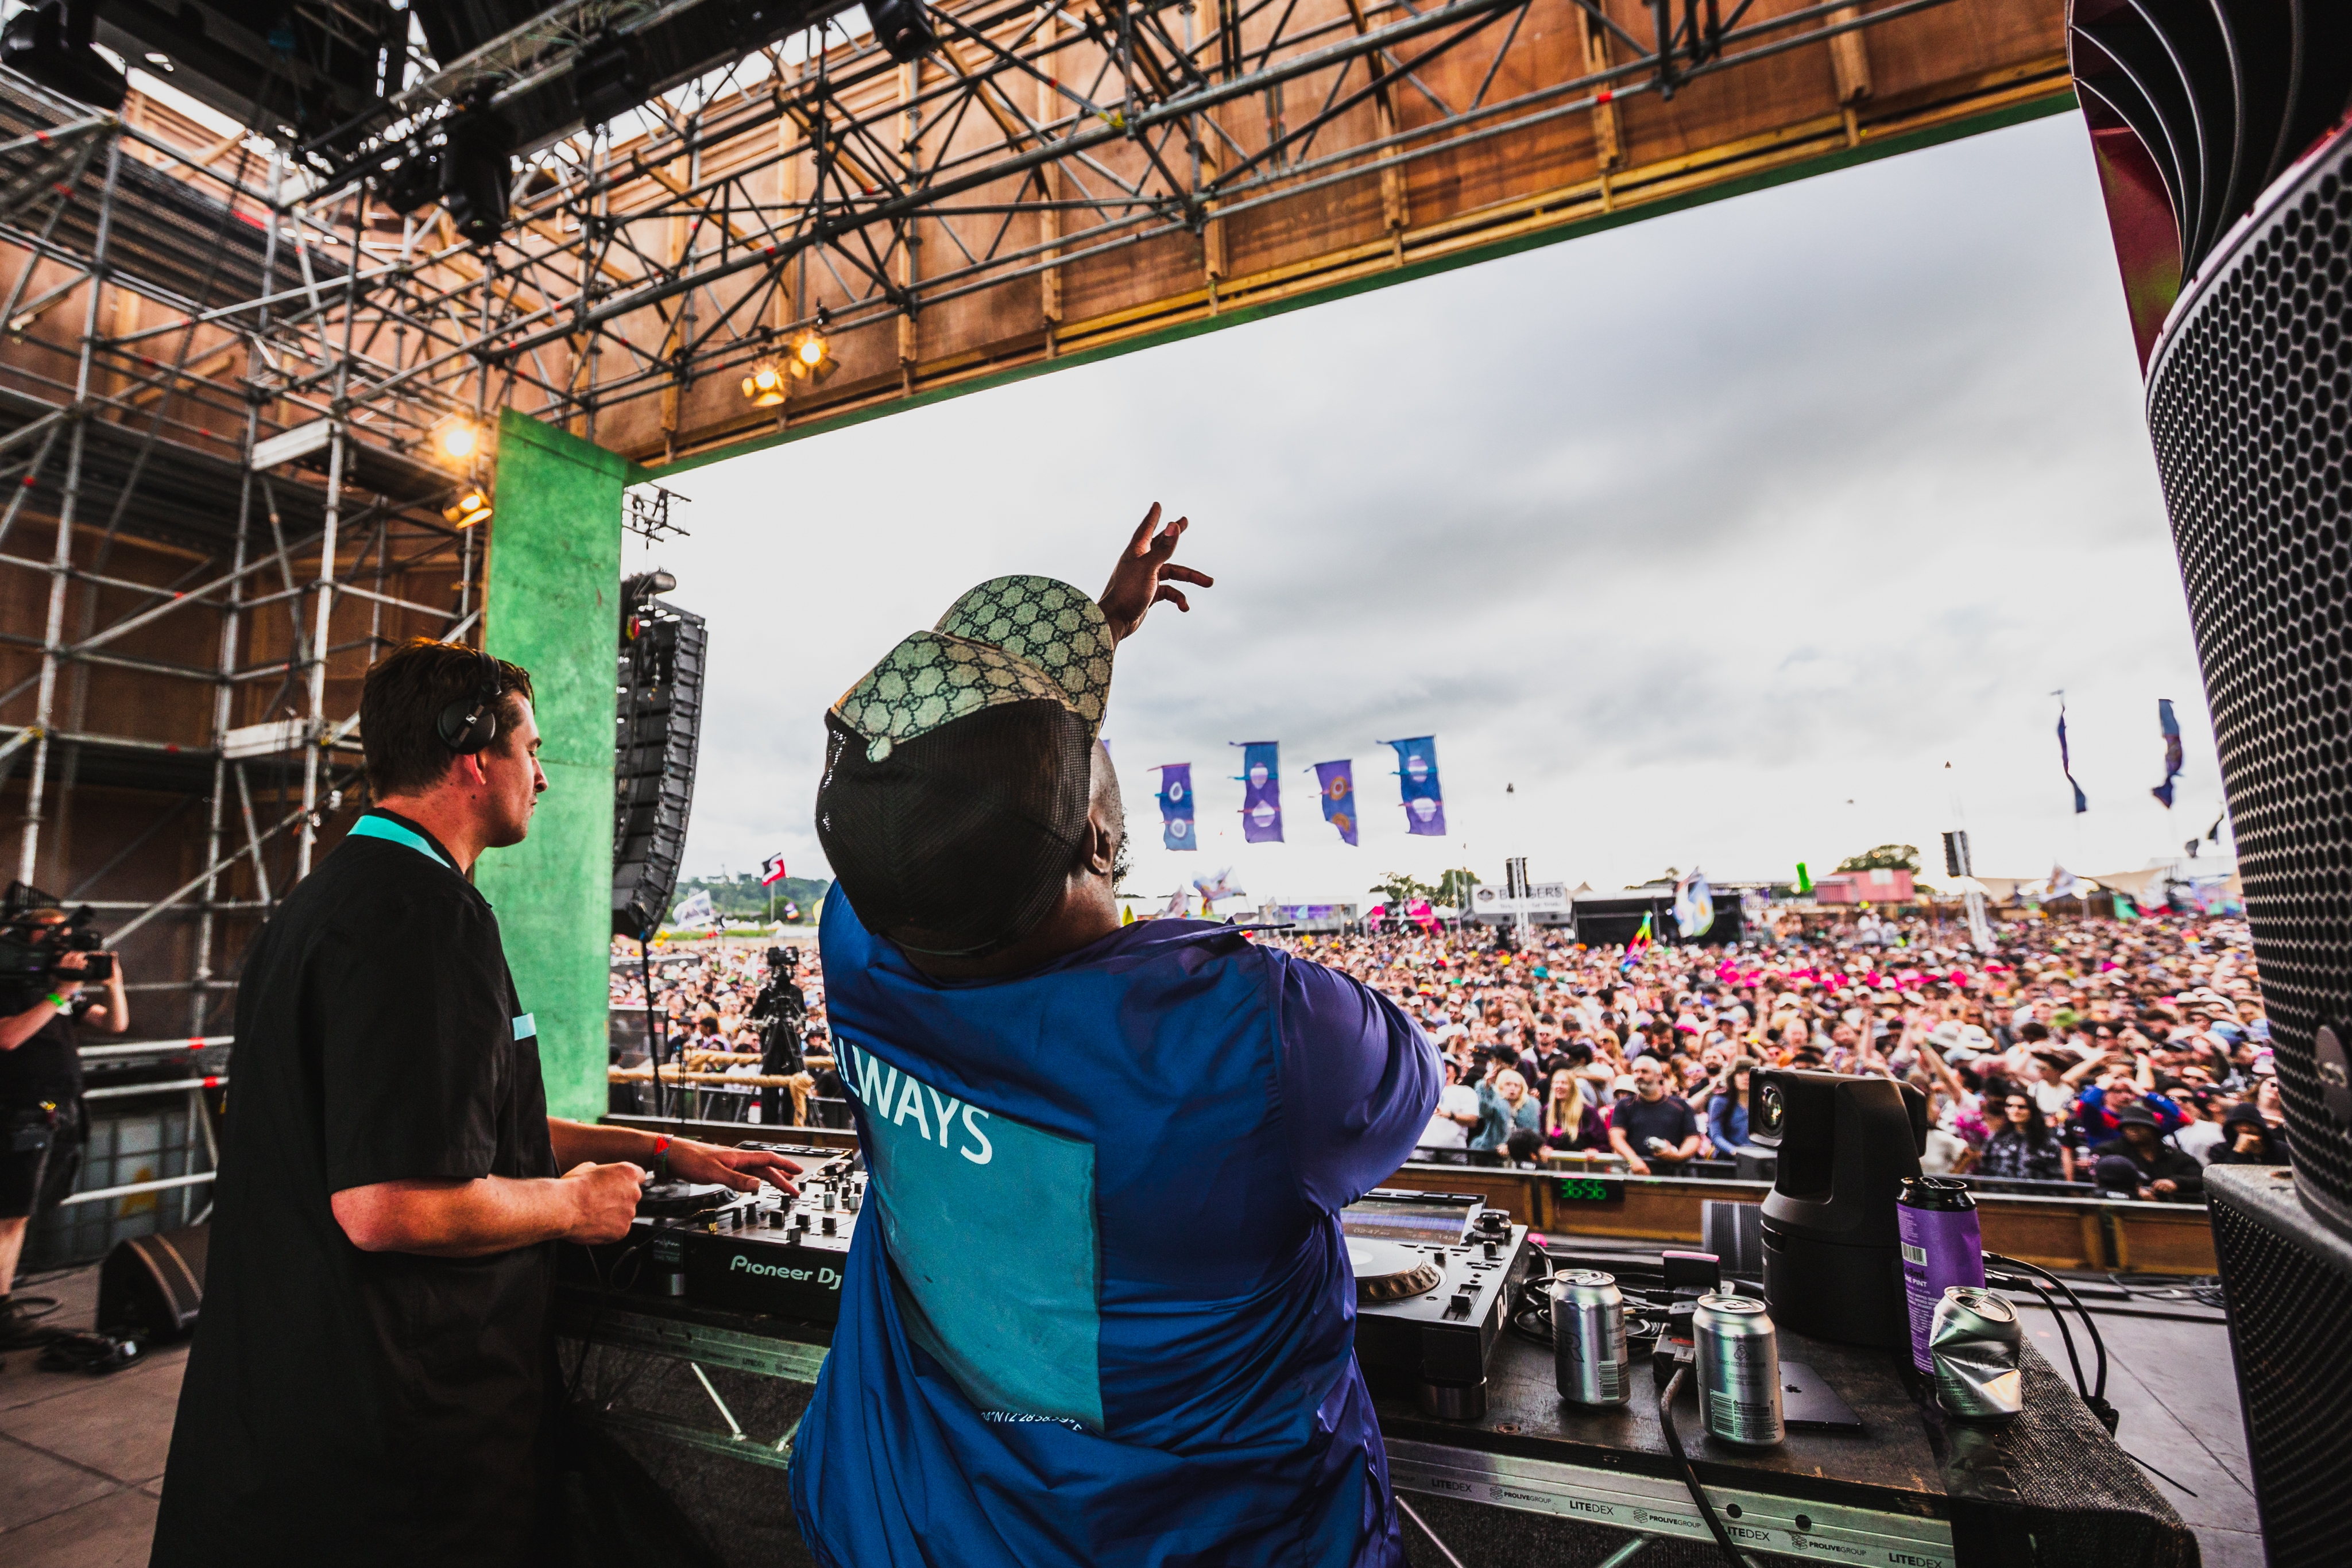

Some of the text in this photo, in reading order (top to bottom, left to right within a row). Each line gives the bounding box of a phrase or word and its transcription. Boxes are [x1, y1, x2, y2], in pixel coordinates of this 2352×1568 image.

[1499, 886, 1562, 900] BGERS
[729, 1255, 814, 1281] Pioneer
[1912, 1279, 1928, 1287] PINT
[1432, 1478, 1472, 1493] LITEDEX
[1503, 1491, 1552, 1504] PROLIVEGROUP
[1569, 1500, 1614, 1516] LITEDEX
[1649, 1515, 1701, 1528] PROLIVEGROUP
[1809, 1540, 1867, 1556] PROLIVEGROUP
[1889, 1552, 1943, 1568] LITEDEX
